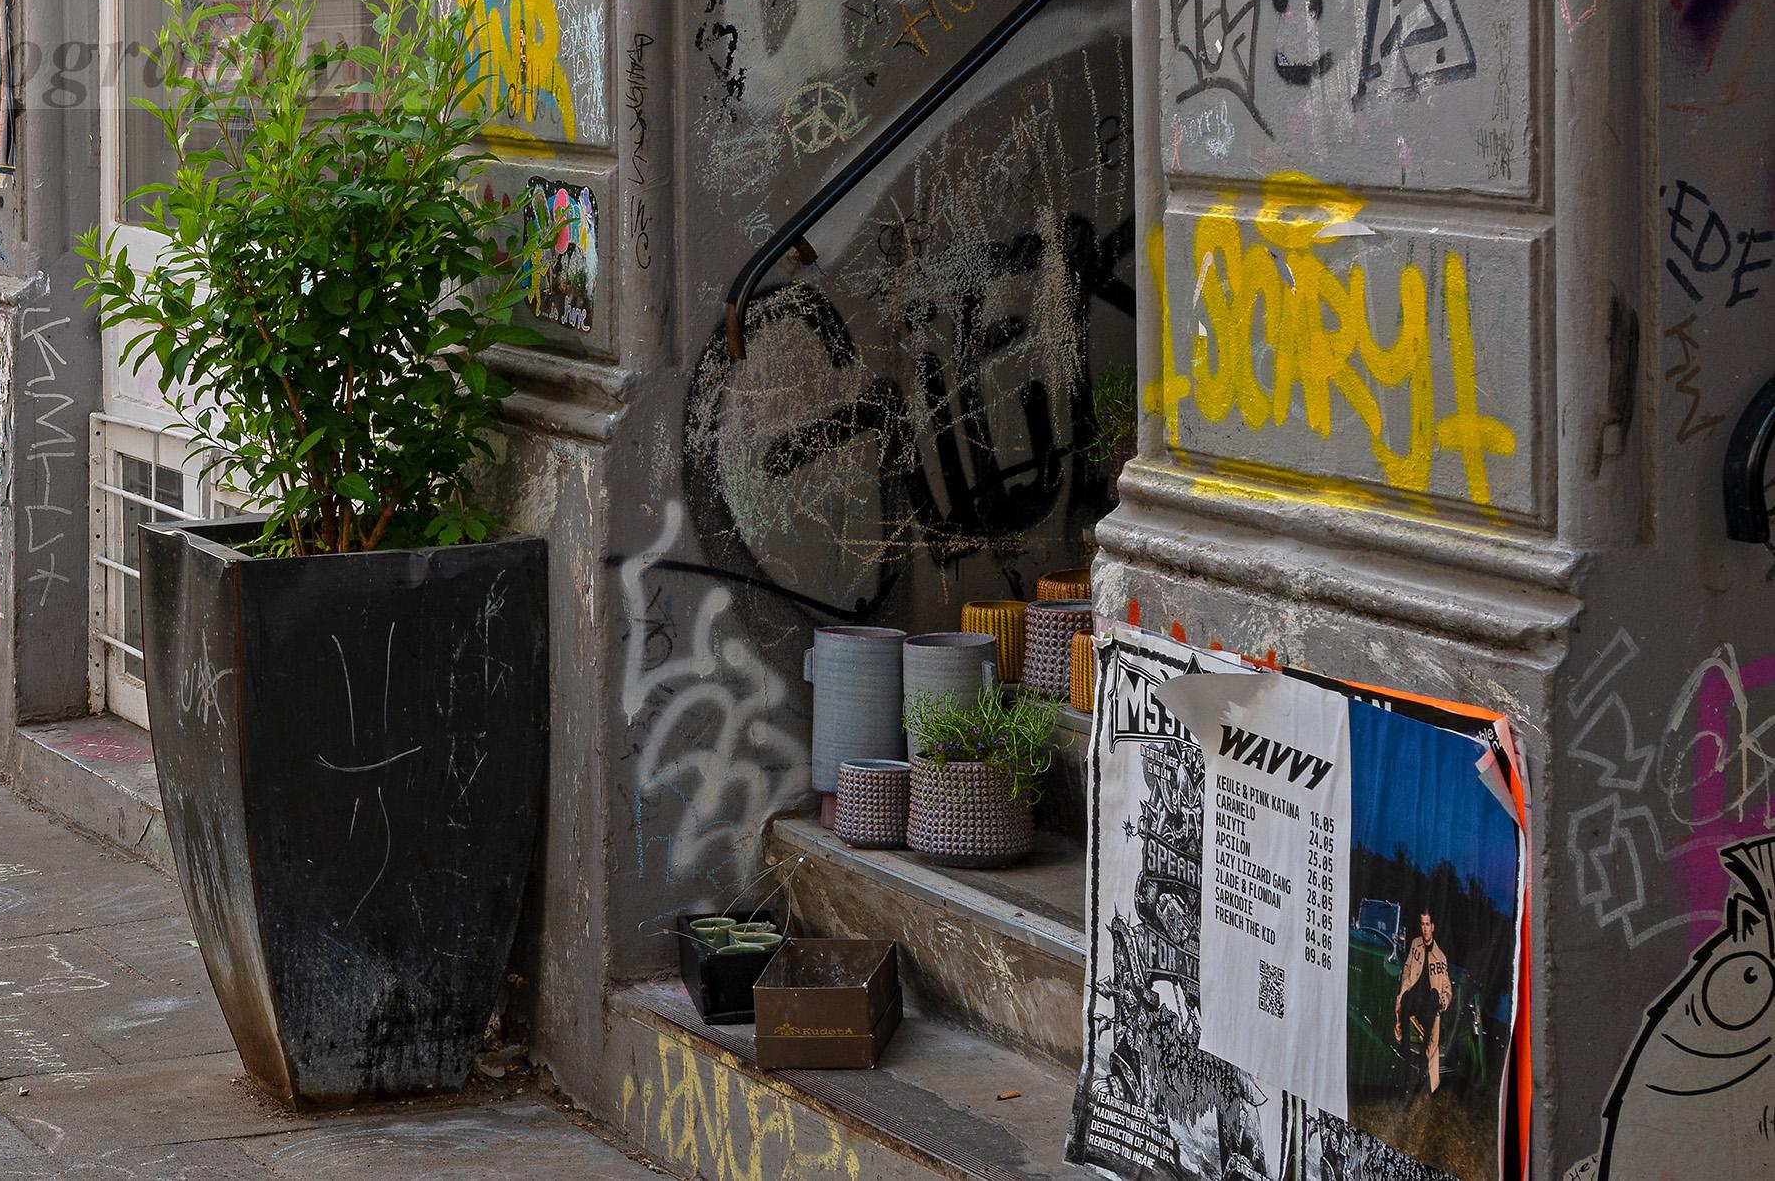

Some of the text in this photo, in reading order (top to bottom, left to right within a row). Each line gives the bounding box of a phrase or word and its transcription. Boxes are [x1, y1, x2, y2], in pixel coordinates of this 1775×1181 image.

[1218, 723, 1334, 791] WAVVY
[1216, 773, 1241, 796] KEULE
[1242, 784, 1248, 798] &
[1249, 786, 1270, 808] PINK
[1310, 810, 1335, 834] 16.05
[1216, 793, 1334, 853] CARAMELO 24.05
[1215, 811, 1333, 873] HAIYTI 25.05
[1215, 830, 1333, 892] APSILON 26.05
[1215, 848, 1333, 912] LAZY LIZZARD GANG 28.05
[1215, 867, 1333, 931] 2LADE & FLOWDAN 31.05
[1215, 886, 1332, 951] SARKODIE 04.06
[1215, 905, 1332, 970] FRENCH THE KID 09.06
[1092, 1105, 1126, 1126] MADNESS
[1125, 1116, 1150, 1136] DWELLS
[1097, 1091, 1124, 1111] TEARING
[1088, 1134, 1156, 1169] RENDERS YOU INSANE
[1090, 1119, 1170, 1163] DESTRUCTION OF YOUR LIFE
